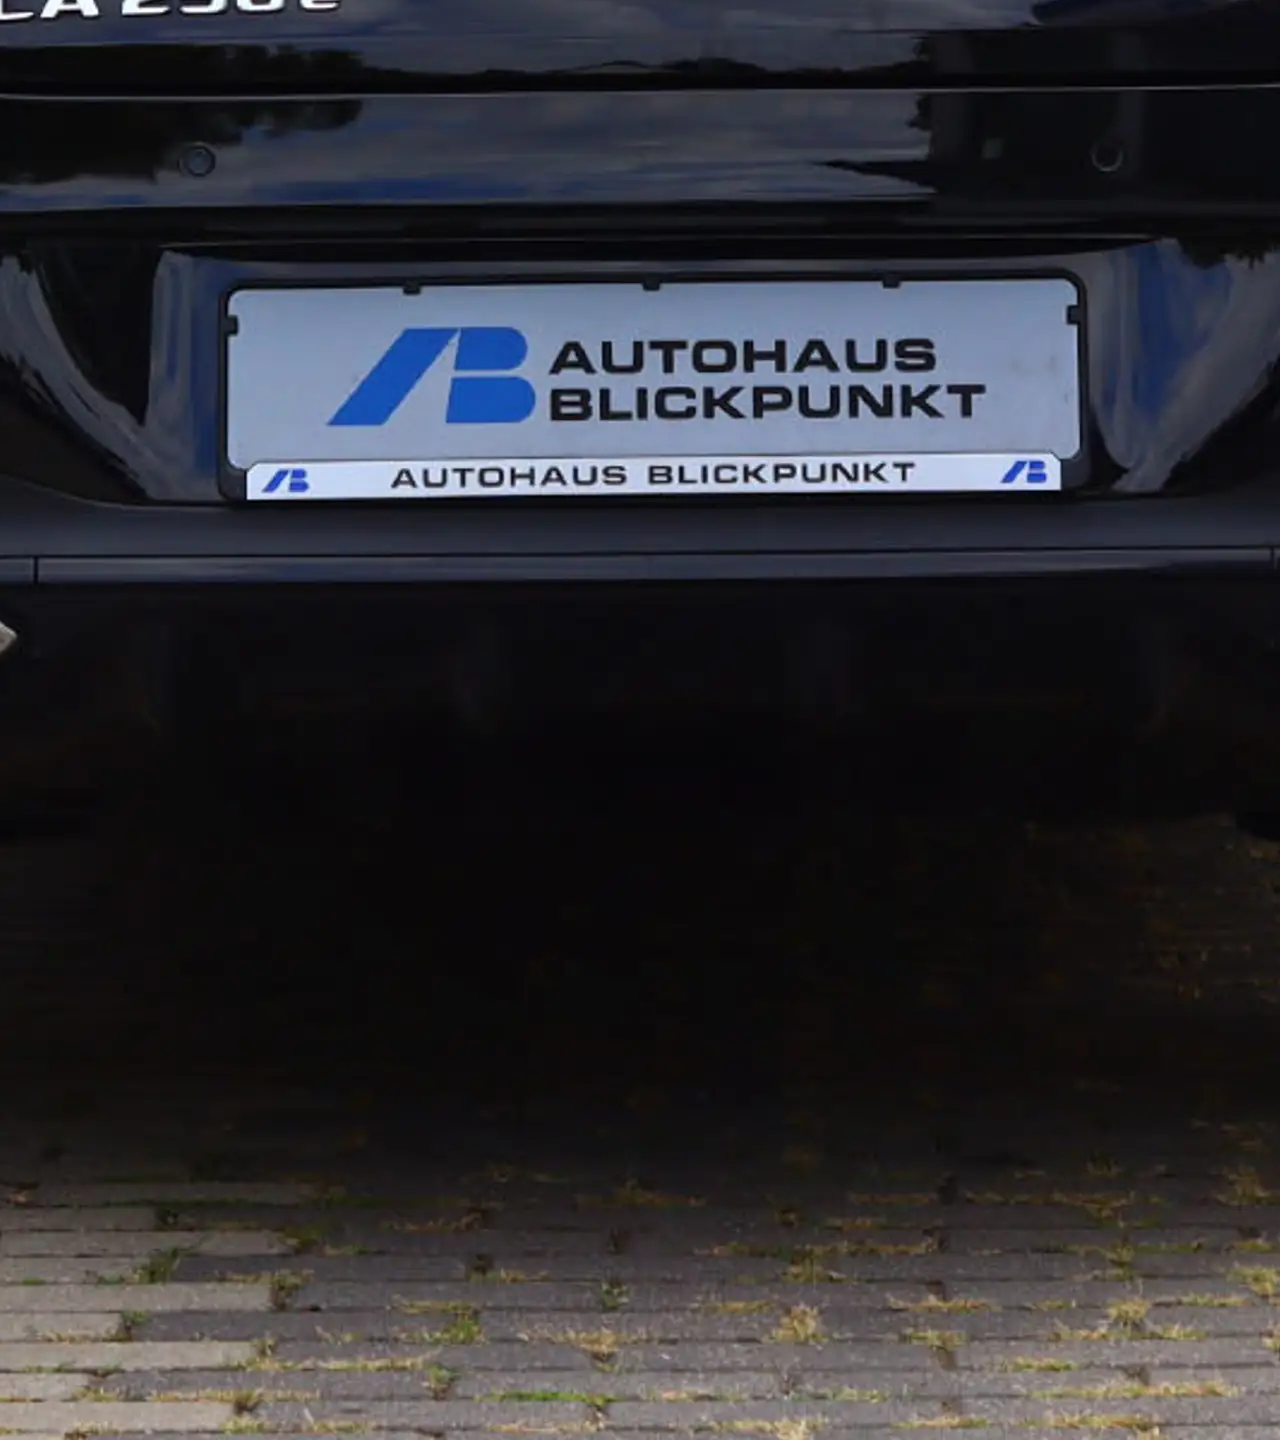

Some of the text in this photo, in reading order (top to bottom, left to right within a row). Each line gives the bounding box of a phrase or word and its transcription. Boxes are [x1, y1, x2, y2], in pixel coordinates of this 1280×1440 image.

[548, 337, 938, 376] AUTOHAUS
[549, 382, 987, 422] BLICKPUNKT
[389, 461, 917, 490] AUTOHAUS BLICKPUNKT
